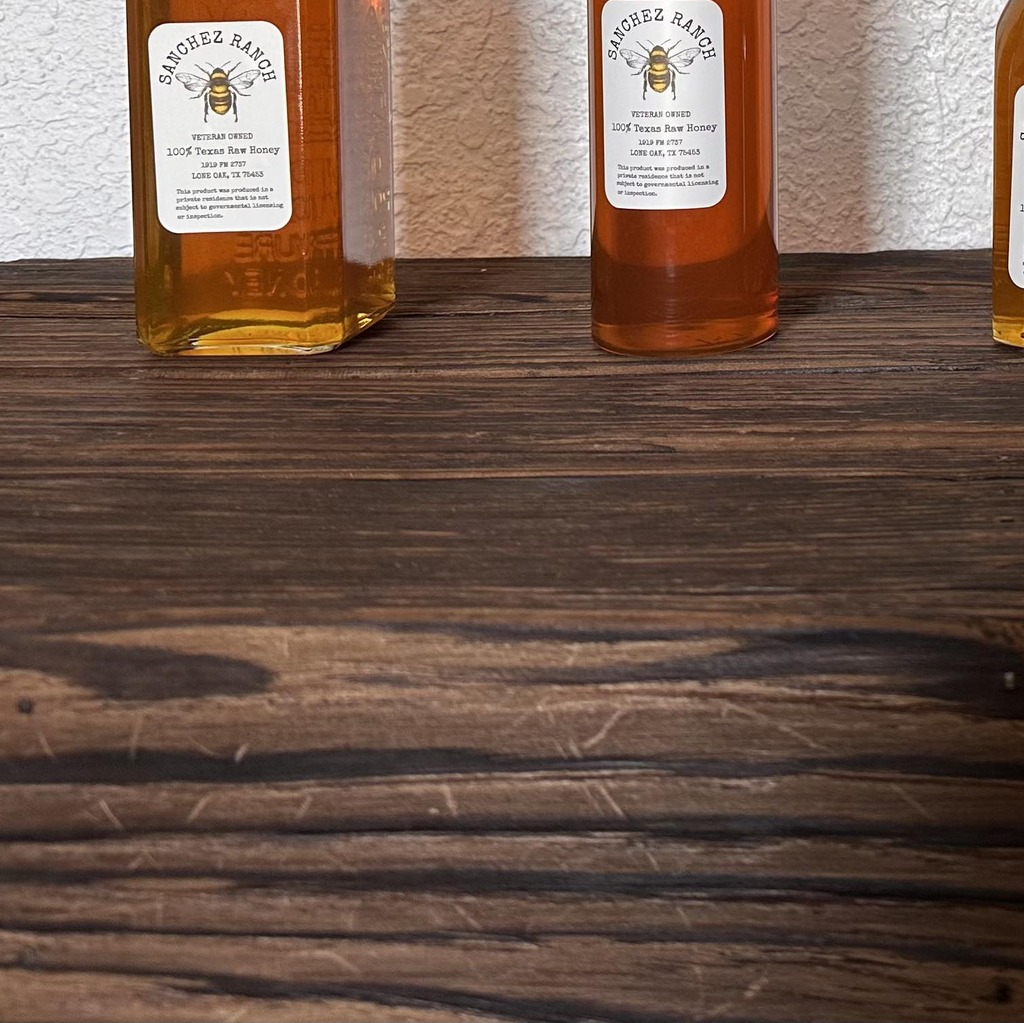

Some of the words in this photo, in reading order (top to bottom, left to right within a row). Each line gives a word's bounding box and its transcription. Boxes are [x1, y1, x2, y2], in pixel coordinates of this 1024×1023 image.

[608, 8, 663, 60] SANCHEZ
[670, 12, 716, 60] RANCH
[159, 31, 223, 85] SANCHEZ
[229, 33, 276, 82] RANCH
[612, 122, 631, 133] 100%
[634, 124, 661, 132] Texas
[665, 124, 684, 132] Raw
[687, 123, 717, 132] Honey
[167, 146, 192, 157] 100%
[195, 147, 224, 155] Texas
[228, 146, 246, 154] Raw
[250, 146, 280, 155] Honey
